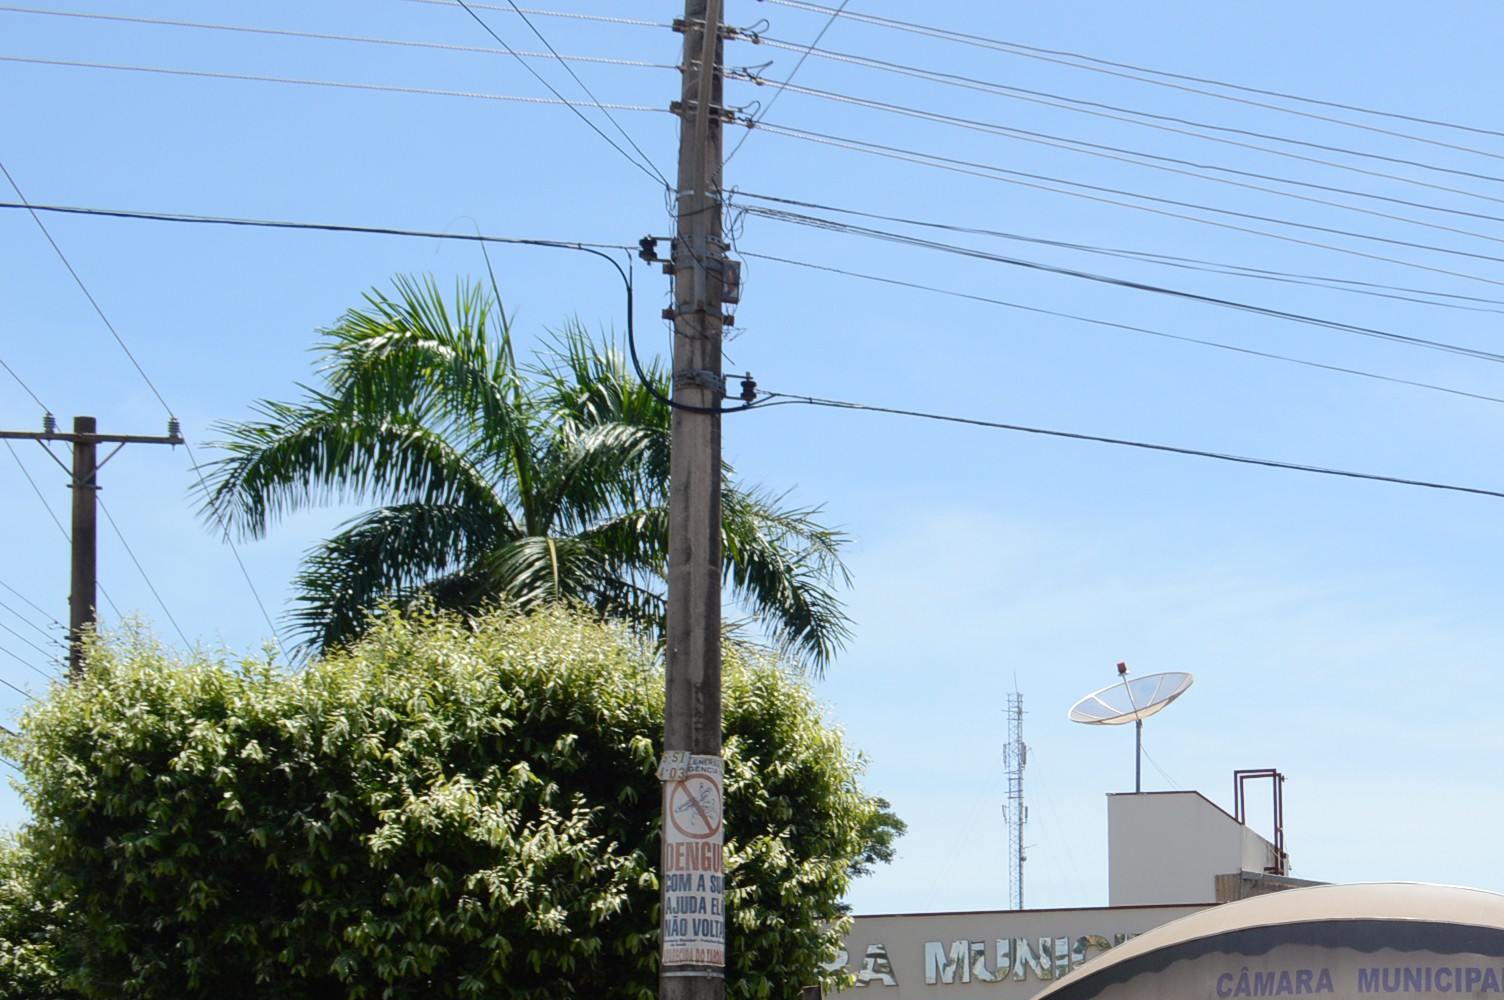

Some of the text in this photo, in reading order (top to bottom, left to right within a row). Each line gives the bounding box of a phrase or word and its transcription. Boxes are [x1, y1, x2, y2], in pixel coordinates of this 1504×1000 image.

[665, 873, 692, 892] COM
[696, 873, 706, 892] A
[665, 895, 707, 914] AJUDA
[665, 915, 688, 937] NÃO
[1215, 966, 1335, 998] CÂMARA
